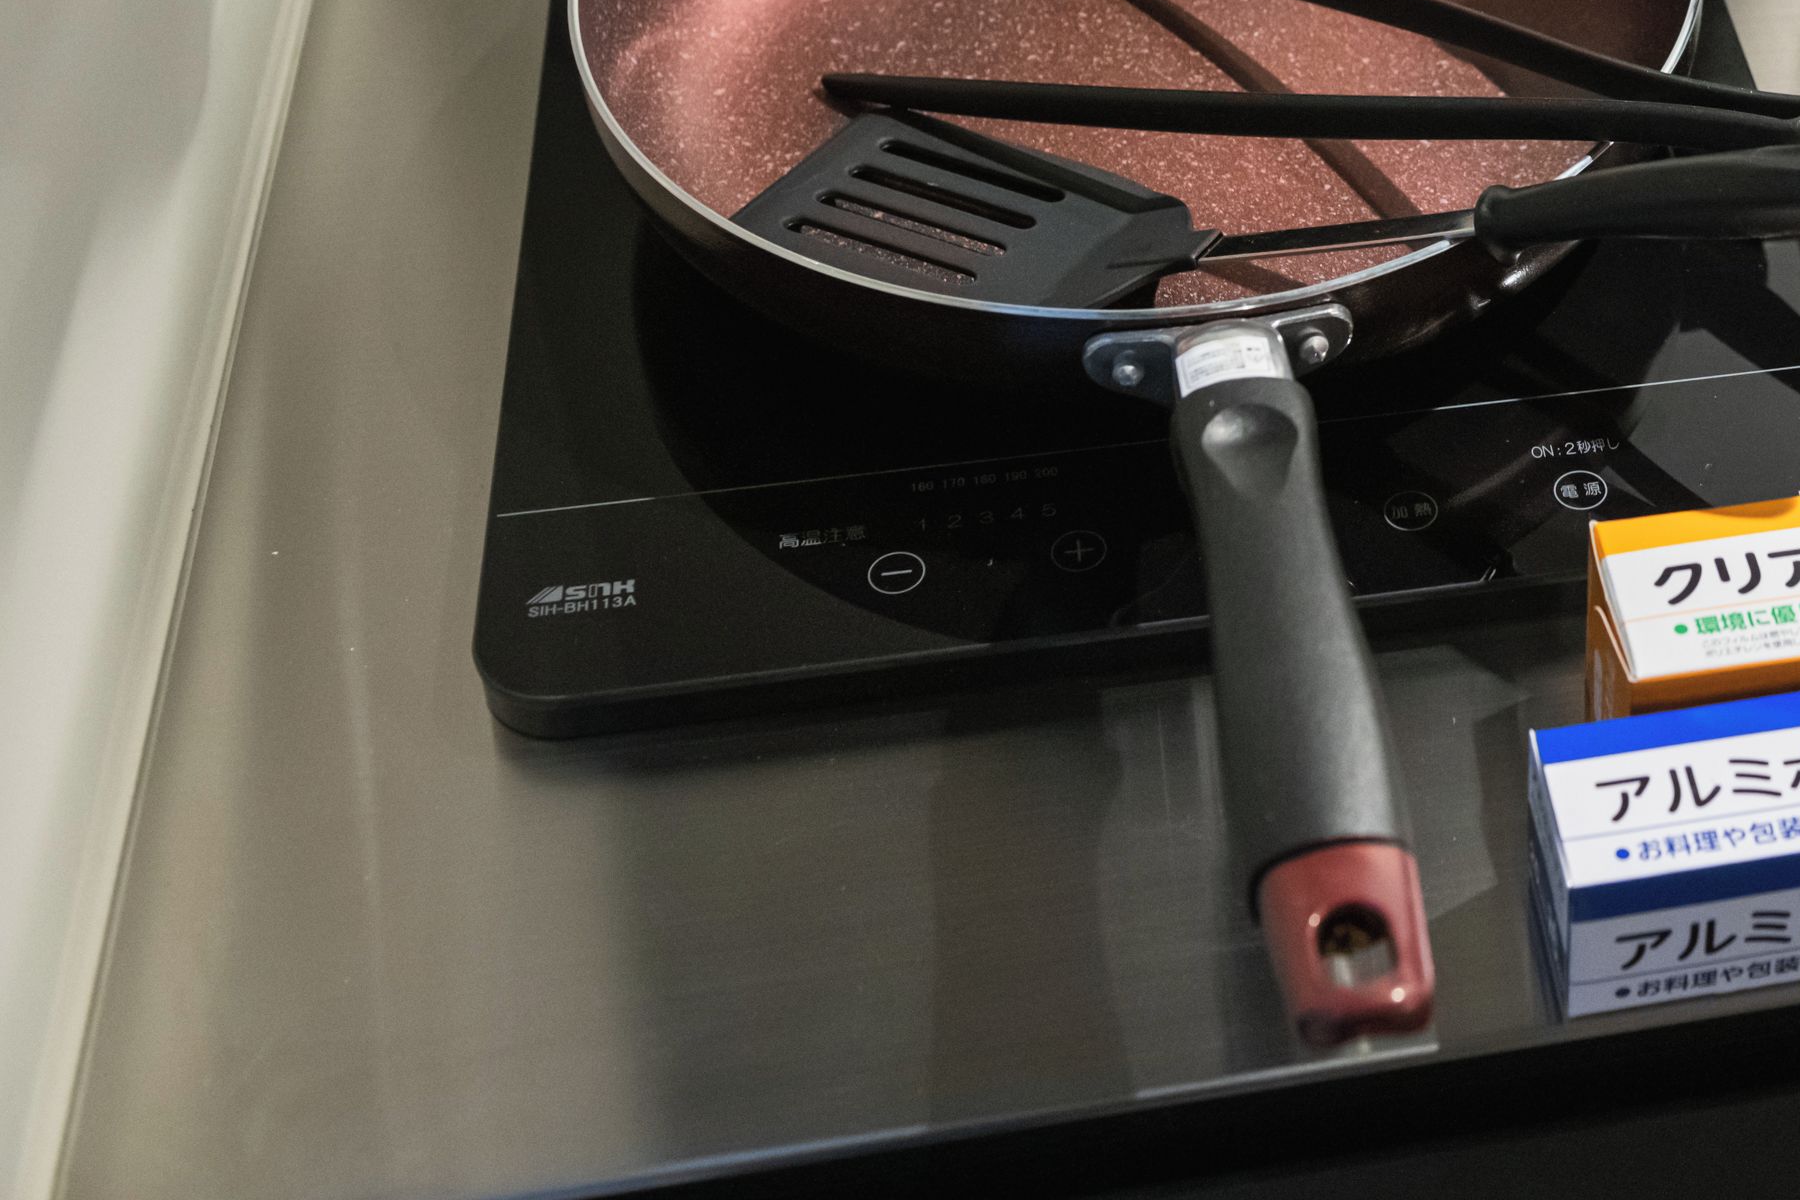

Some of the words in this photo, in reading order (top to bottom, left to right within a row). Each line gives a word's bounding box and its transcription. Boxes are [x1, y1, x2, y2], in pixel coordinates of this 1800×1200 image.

[947, 513, 963, 529] 2
[978, 510, 994, 526] 3
[1010, 506, 1025, 520] 4
[1040, 502, 1057, 517] 5
[778, 524, 867, 550] 高温注意
[527, 595, 637, 618] SIH-BH113A
